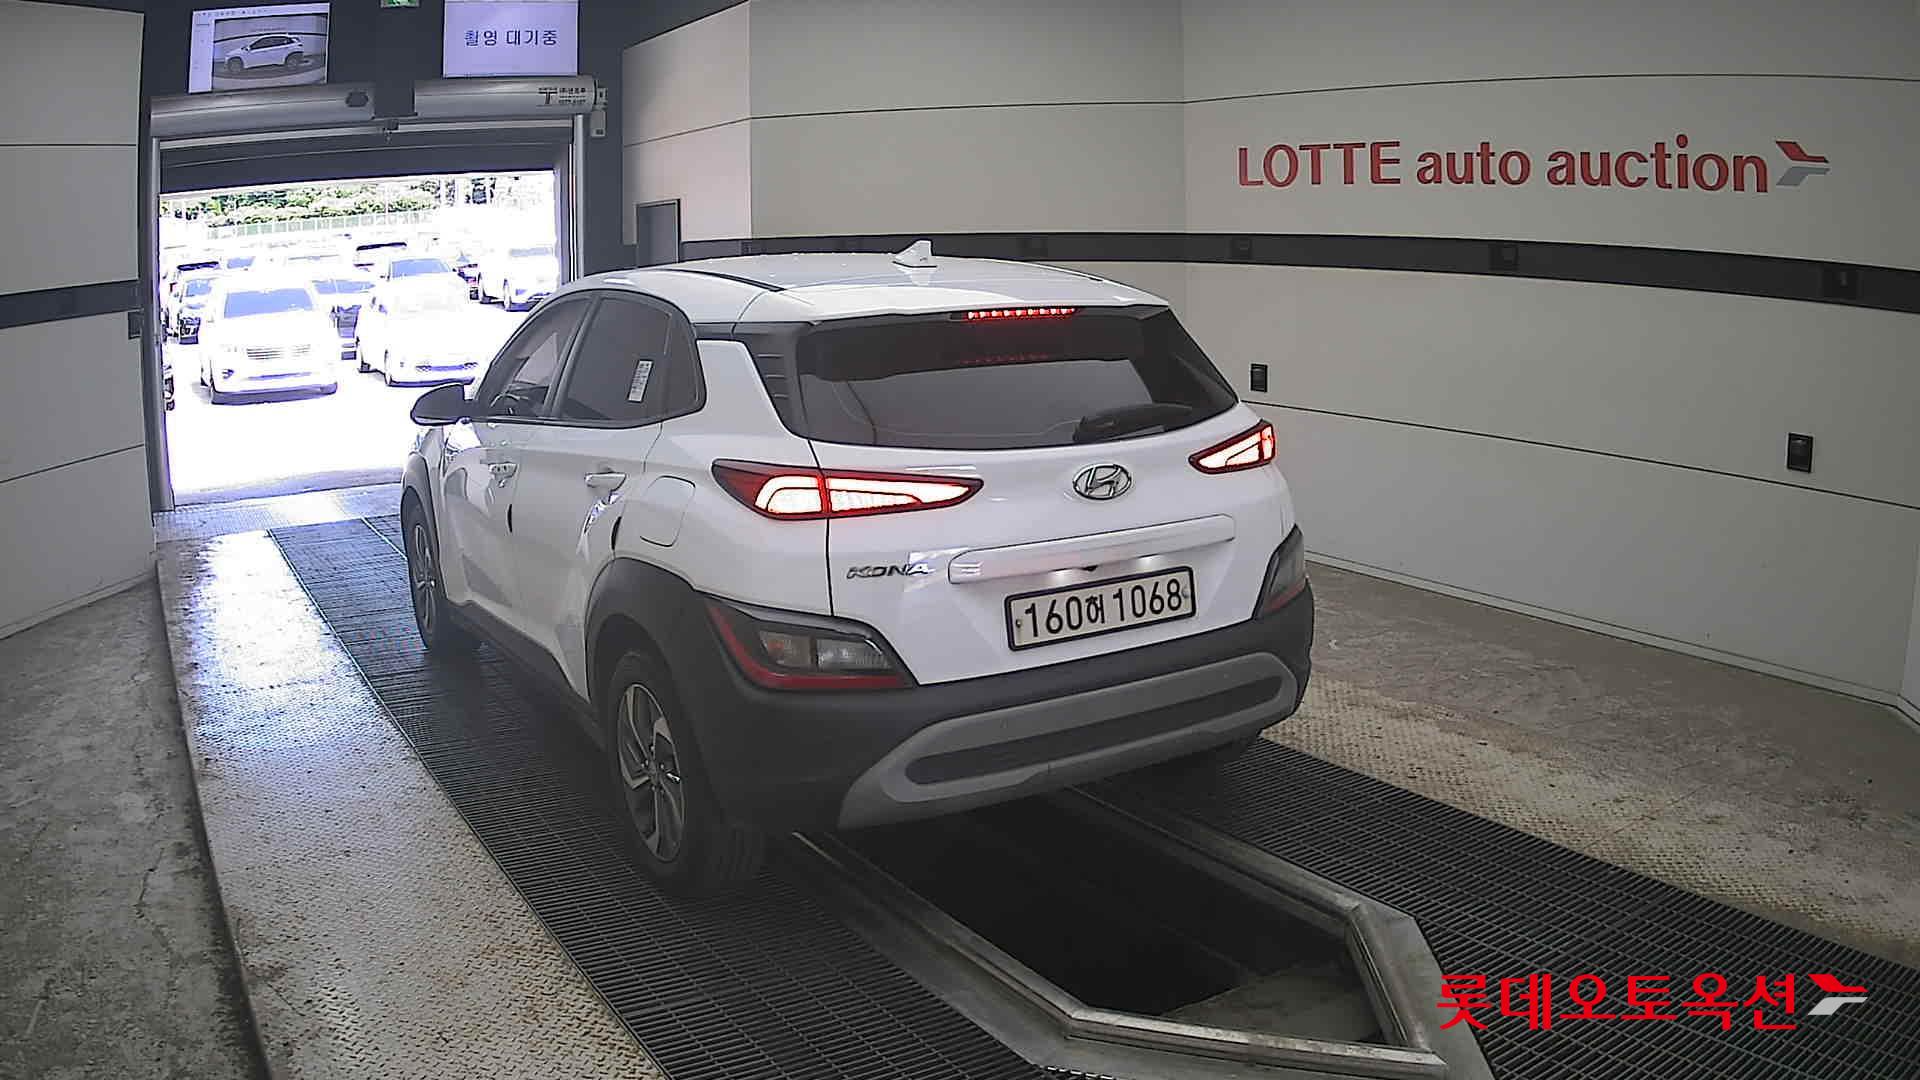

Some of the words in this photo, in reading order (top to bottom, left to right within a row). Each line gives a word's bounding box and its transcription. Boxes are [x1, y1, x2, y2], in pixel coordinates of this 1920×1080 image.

[506, 29, 557, 46] 대기중
[1238, 141, 1401, 187] LOTTE
[1416, 142, 1531, 187] auto
[1547, 135, 1768, 193] auction
[846, 563, 931, 579] KONA
[1113, 578, 1182, 622] 1068
